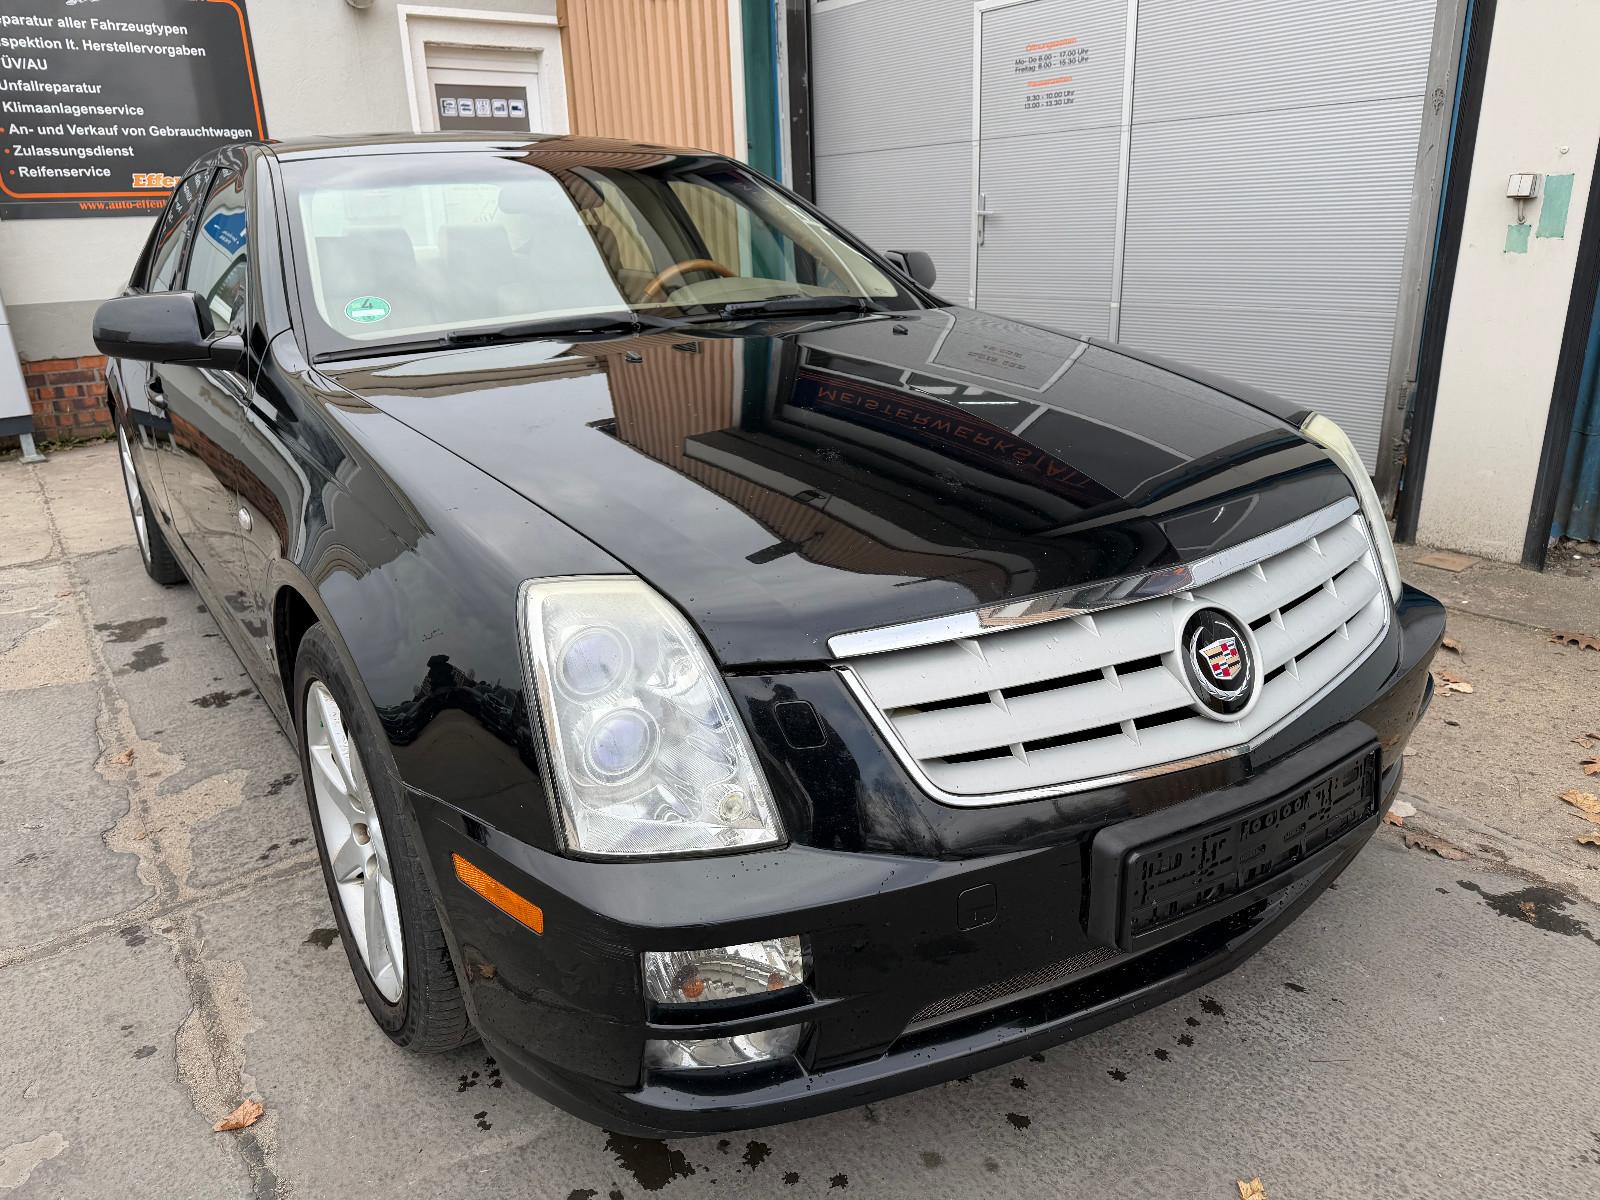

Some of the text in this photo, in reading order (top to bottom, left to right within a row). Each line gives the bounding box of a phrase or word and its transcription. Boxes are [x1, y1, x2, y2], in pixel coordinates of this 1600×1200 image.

[0, 15, 188, 35] paratur aller Fahrzeugtypen
[0, 36, 206, 57] spektion lt. Herstellervorgaben
[1059, 49, 1077, 58] 17.00
[0, 54, 48, 70] ÜV/AU
[1077, 56, 1089, 64] Uhr
[0, 80, 102, 95] Unfallreparatur
[1046, 91, 1063, 99] 10.00
[2, 101, 145, 116] Klimaanlagenservice
[8, 124, 253, 138] An- und Verkauf von Gebrauchtwagen
[12, 145, 135, 159] Zulassungsdienst
[18, 166, 112, 178] Reifenservice
[361, 298, 374, 309] 4
